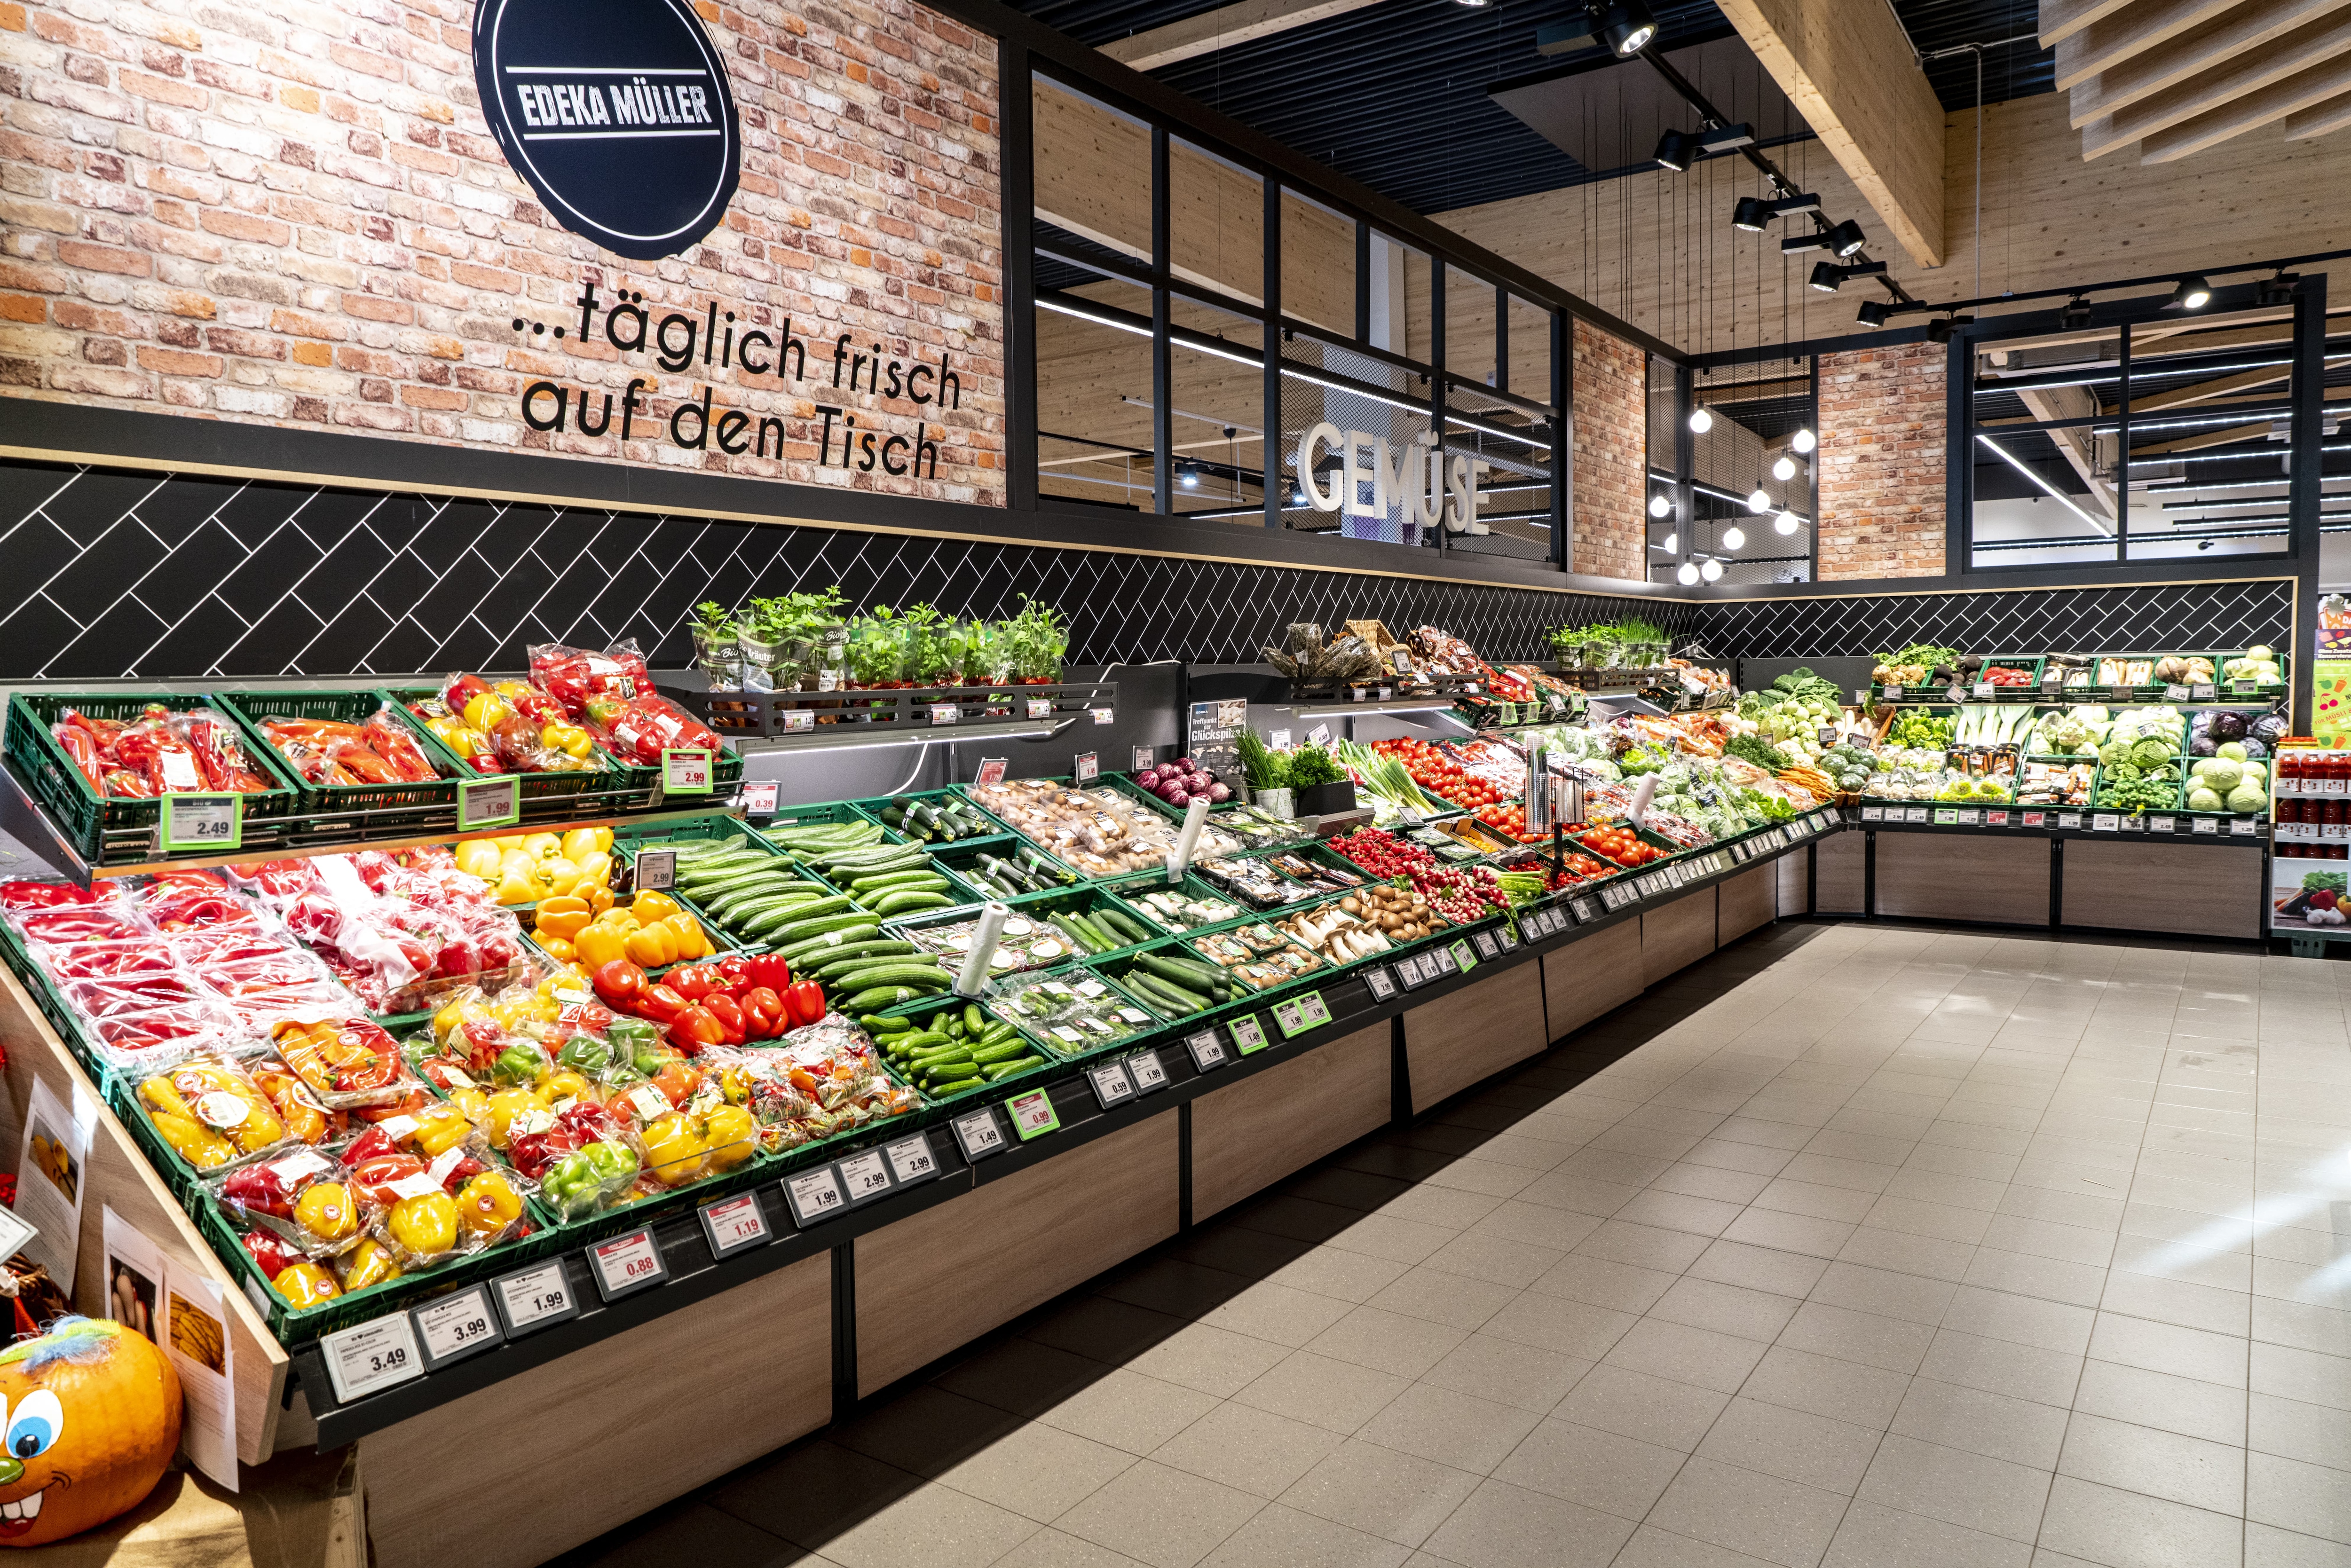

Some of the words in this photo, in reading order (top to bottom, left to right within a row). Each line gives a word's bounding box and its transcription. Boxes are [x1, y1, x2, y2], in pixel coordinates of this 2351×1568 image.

[518, 83, 608, 127] EDEKA
[608, 77, 712, 125] MÜLLER
[833, 334, 960, 410] frisch
[521, 378, 646, 440] auf
[671, 387, 783, 460] den
[815, 405, 937, 480] Tisch
[1297, 422, 1489, 535] GEMÜSE
[825, 631, 840, 641] Bio
[721, 648, 738, 658] Bio
[738, 641, 747, 652] Bio
[748, 647, 775, 662] Kräuter
[2326, 710, 2347, 721] MÜSLI
[1318, 733, 1327, 742] 0.69
[686, 772, 704, 782] 2.99
[486, 802, 510, 814] 1.99
[197, 822, 229, 834] 2.49
[653, 873, 669, 882] 2.99
[1381, 983, 1391, 991] 2.99
[1313, 1007, 1324, 1016] 1.99
[1291, 1016, 1302, 1025] 1.99
[1248, 1032, 1260, 1042] 1.49
[1207, 1047, 1220, 1058] 1.99
[1147, 1069, 1161, 1080] 1.99
[1112, 1081, 1127, 1093] 0.59
[1033, 1111, 1049, 1124] 0.99
[979, 1130, 997, 1144] 1.49
[910, 1156, 930, 1172] 2.99
[864, 1172, 885, 1188] 2.99
[815, 1190, 837, 1206] 1.99
[734, 1219, 759, 1236] 1.19
[626, 1257, 654, 1276] 0.88
[445, 1300, 464, 1309] Lebensmittel
[534, 1292, 563, 1310] 1.99
[363, 1328, 383, 1338] Lebensmittel
[454, 1318, 486, 1340] 3.99
[340, 1345, 354, 1353] PAPRIKA
[371, 1348, 406, 1371] 3.49
